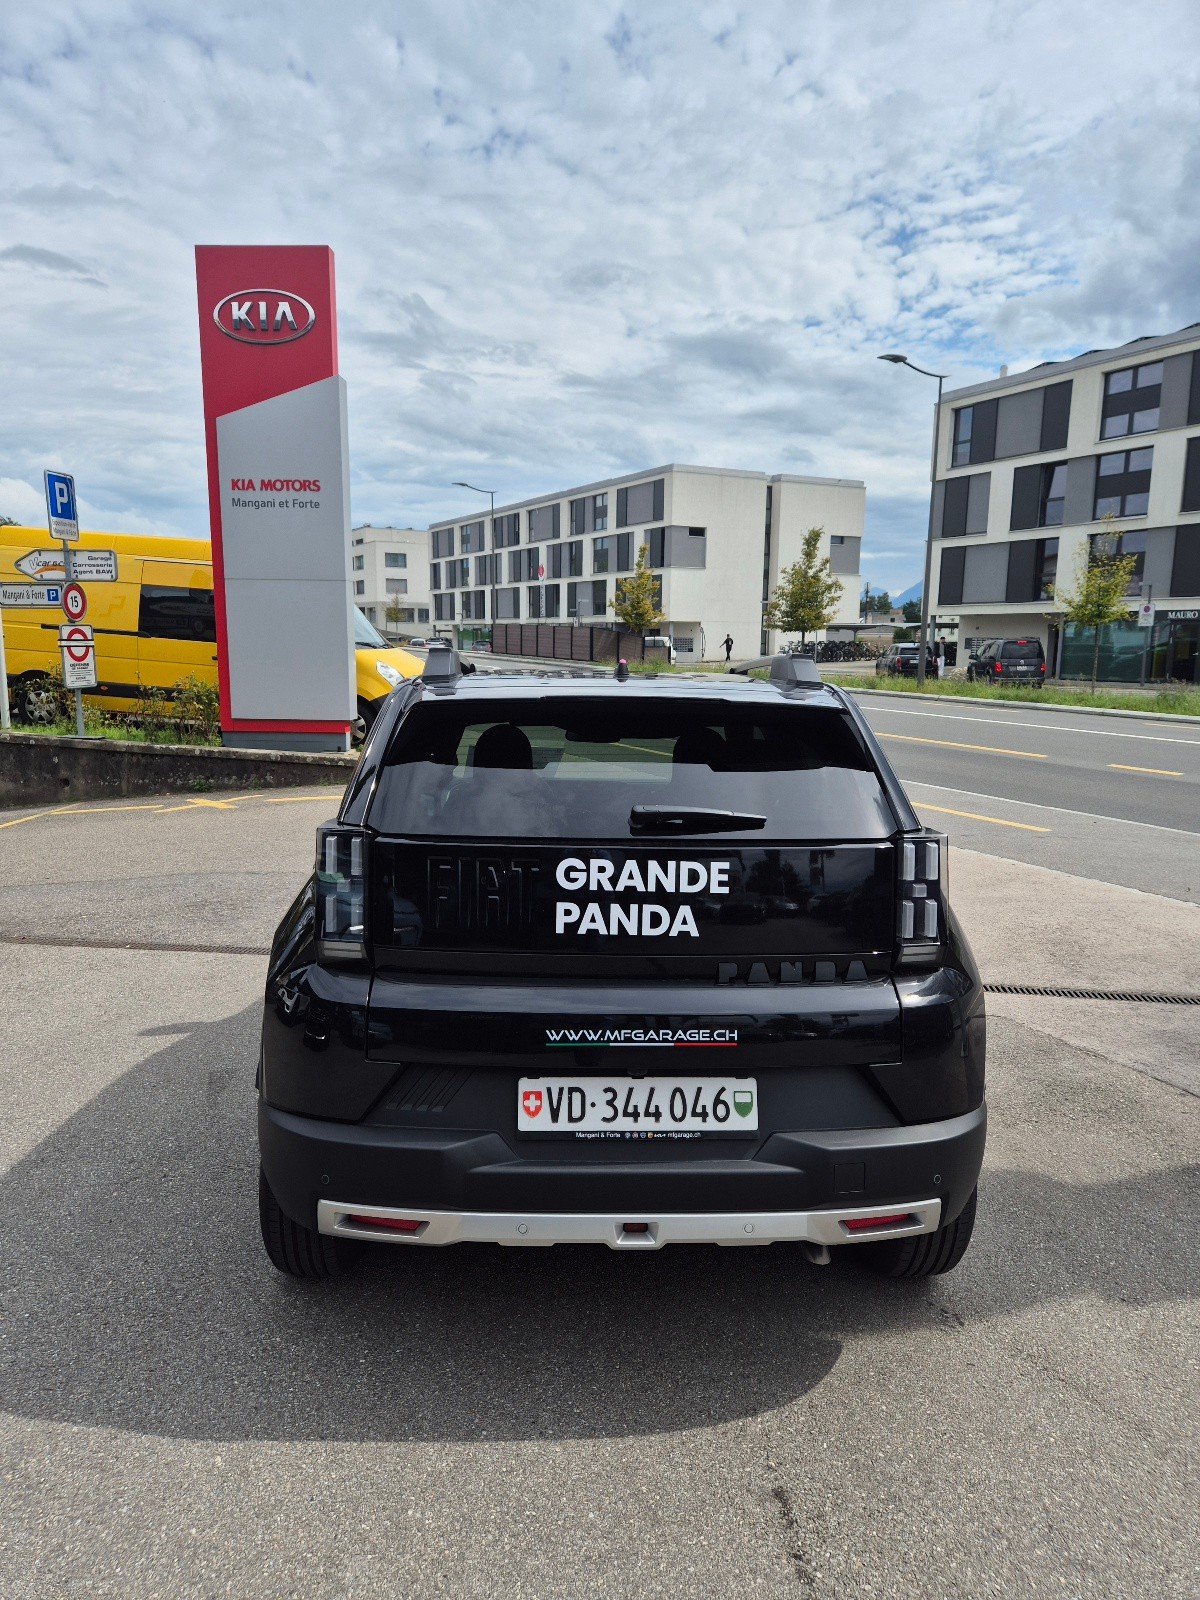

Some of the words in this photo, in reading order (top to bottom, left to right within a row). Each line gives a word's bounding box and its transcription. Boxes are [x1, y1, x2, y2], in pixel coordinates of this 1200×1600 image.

[230, 301, 298, 331] KIA
[231, 478, 256, 491] KIA
[260, 479, 321, 492] MOTORS
[54, 481, 69, 514] P
[231, 497, 276, 510] Mangani
[278, 500, 290, 509] et
[292, 499, 320, 509] Forte
[2, 589, 25, 602] Mangani
[26, 590, 31, 600] &
[31, 590, 46, 600] Forte
[70, 595, 79, 608] 15
[1167, 610, 1199, 619] MAURO
[555, 857, 731, 894] GRANDE
[555, 901, 700, 938] PANDA
[717, 960, 869, 984] PANDA
[545, 1029, 738, 1041] WWW.MFGARAGE.CH
[575, 1131, 600, 1139] Mangani
